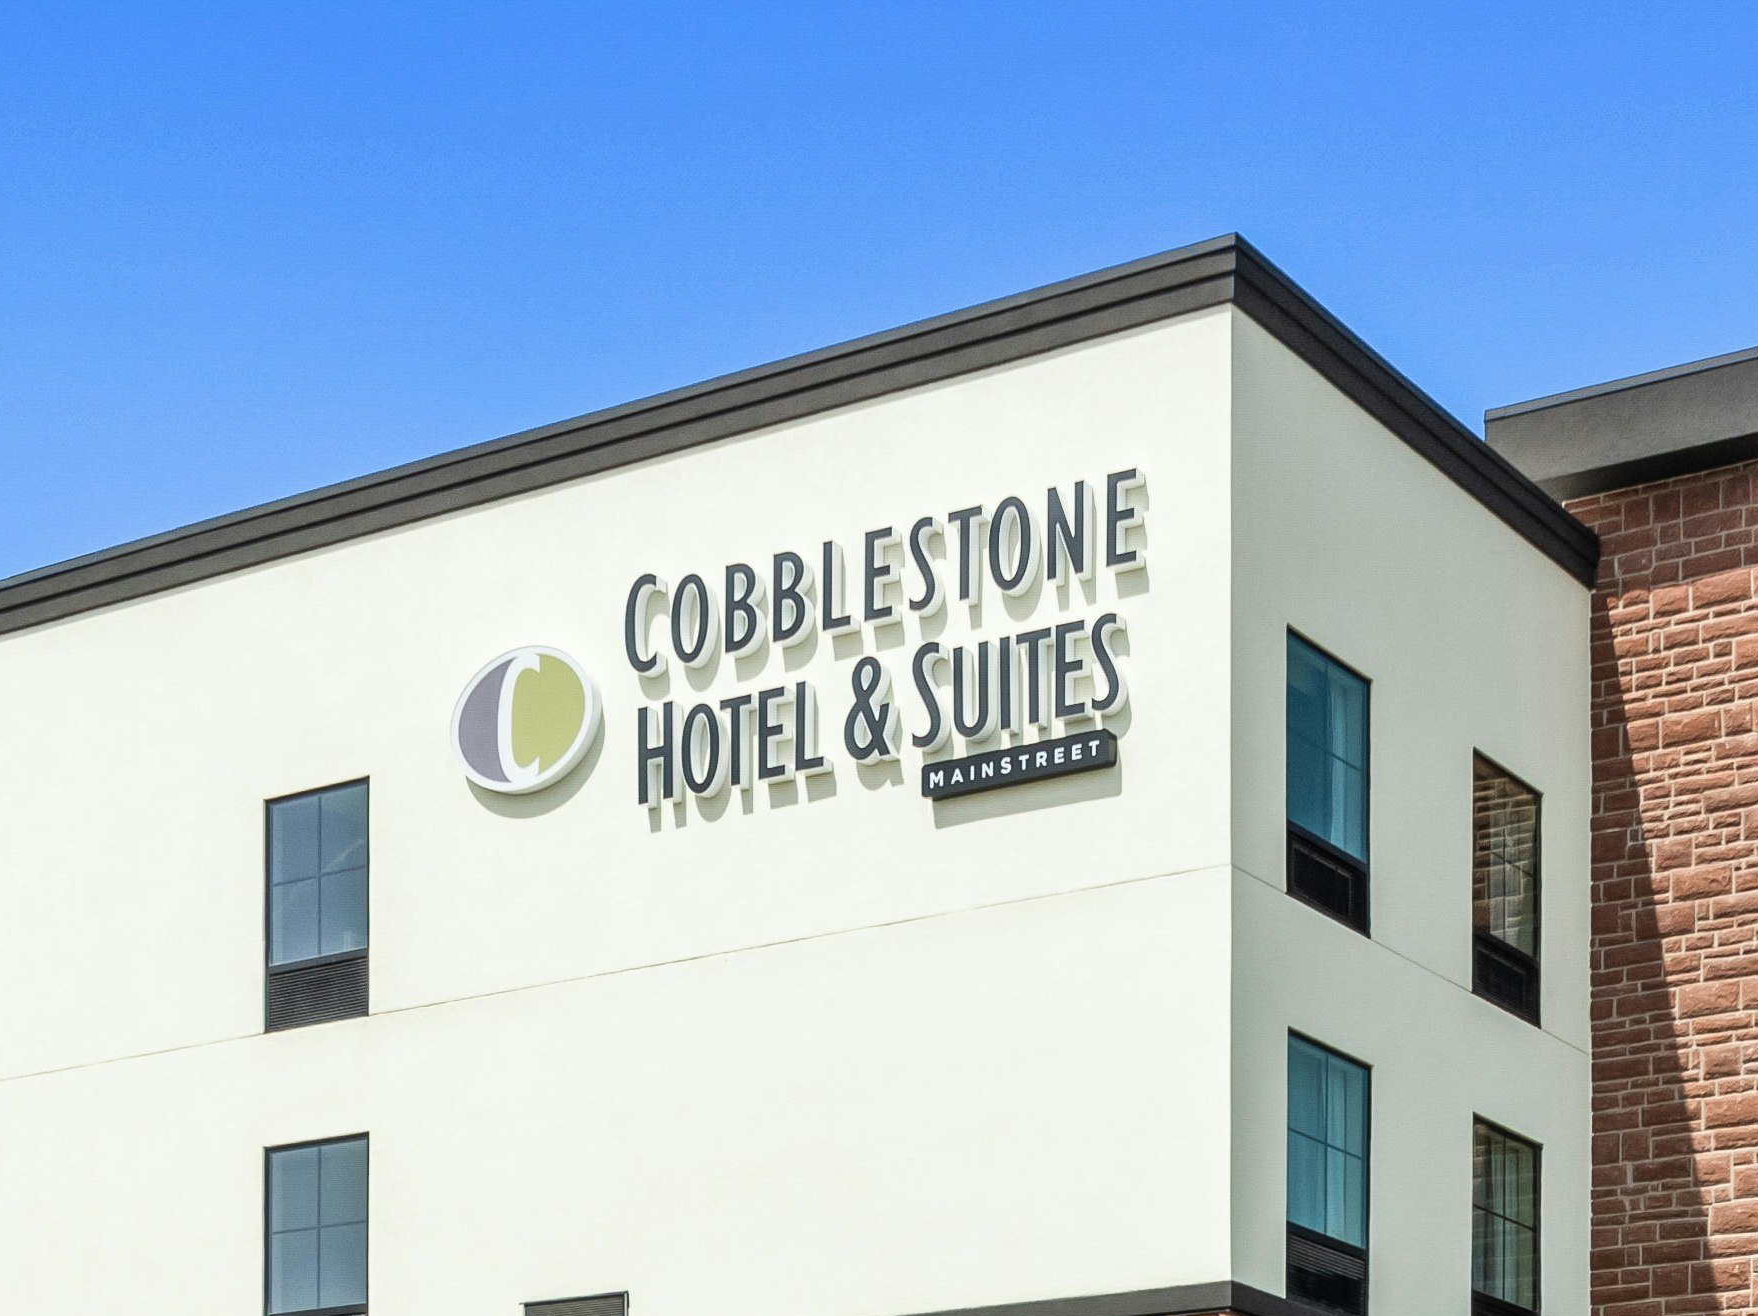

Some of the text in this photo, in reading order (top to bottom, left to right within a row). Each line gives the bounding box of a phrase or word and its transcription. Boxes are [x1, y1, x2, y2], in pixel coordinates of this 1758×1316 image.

[624, 468, 1141, 674] COBBLESTONE
[637, 613, 1122, 805] HOTEL & SUITES
[928, 738, 1101, 791] MAINSTREET
